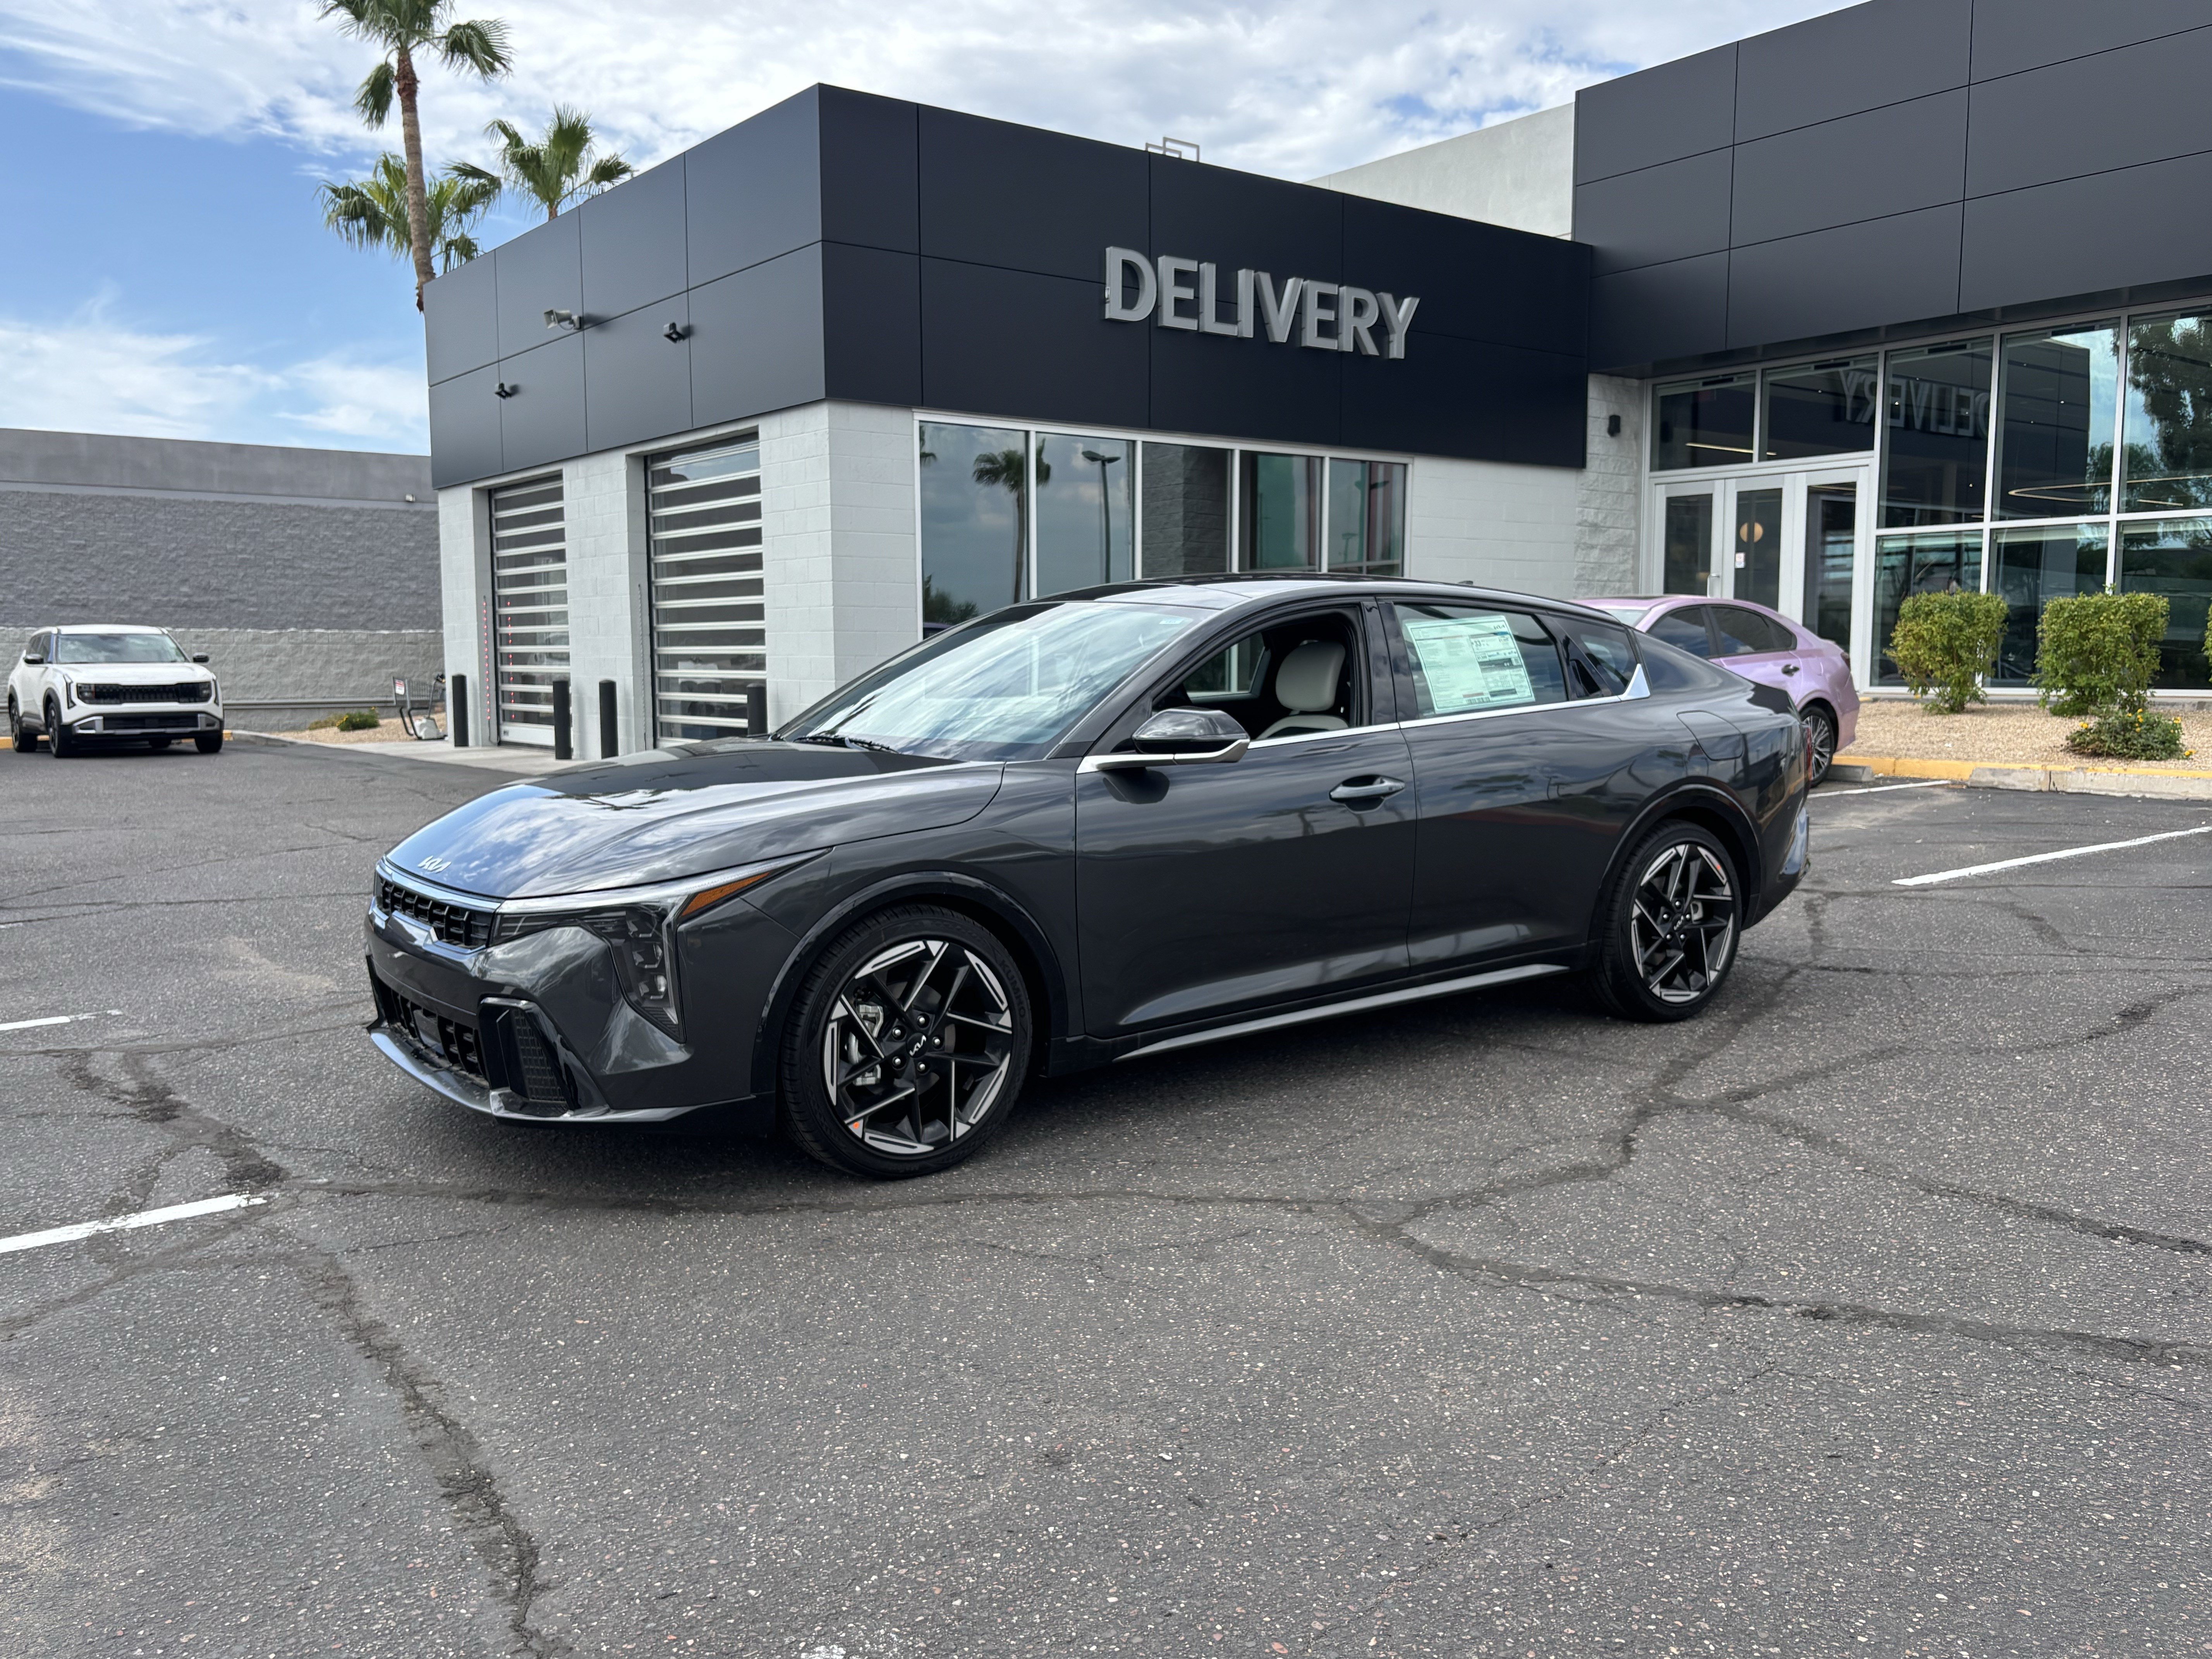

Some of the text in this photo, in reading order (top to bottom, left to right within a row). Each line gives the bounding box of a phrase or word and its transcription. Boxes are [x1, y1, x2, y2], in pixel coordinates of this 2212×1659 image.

[1105, 246, 1420, 359] DELIVERY
[417, 855, 452, 873] KIA
[999, 959, 1026, 1017] KUMHO
[909, 1035, 927, 1056] KIA
